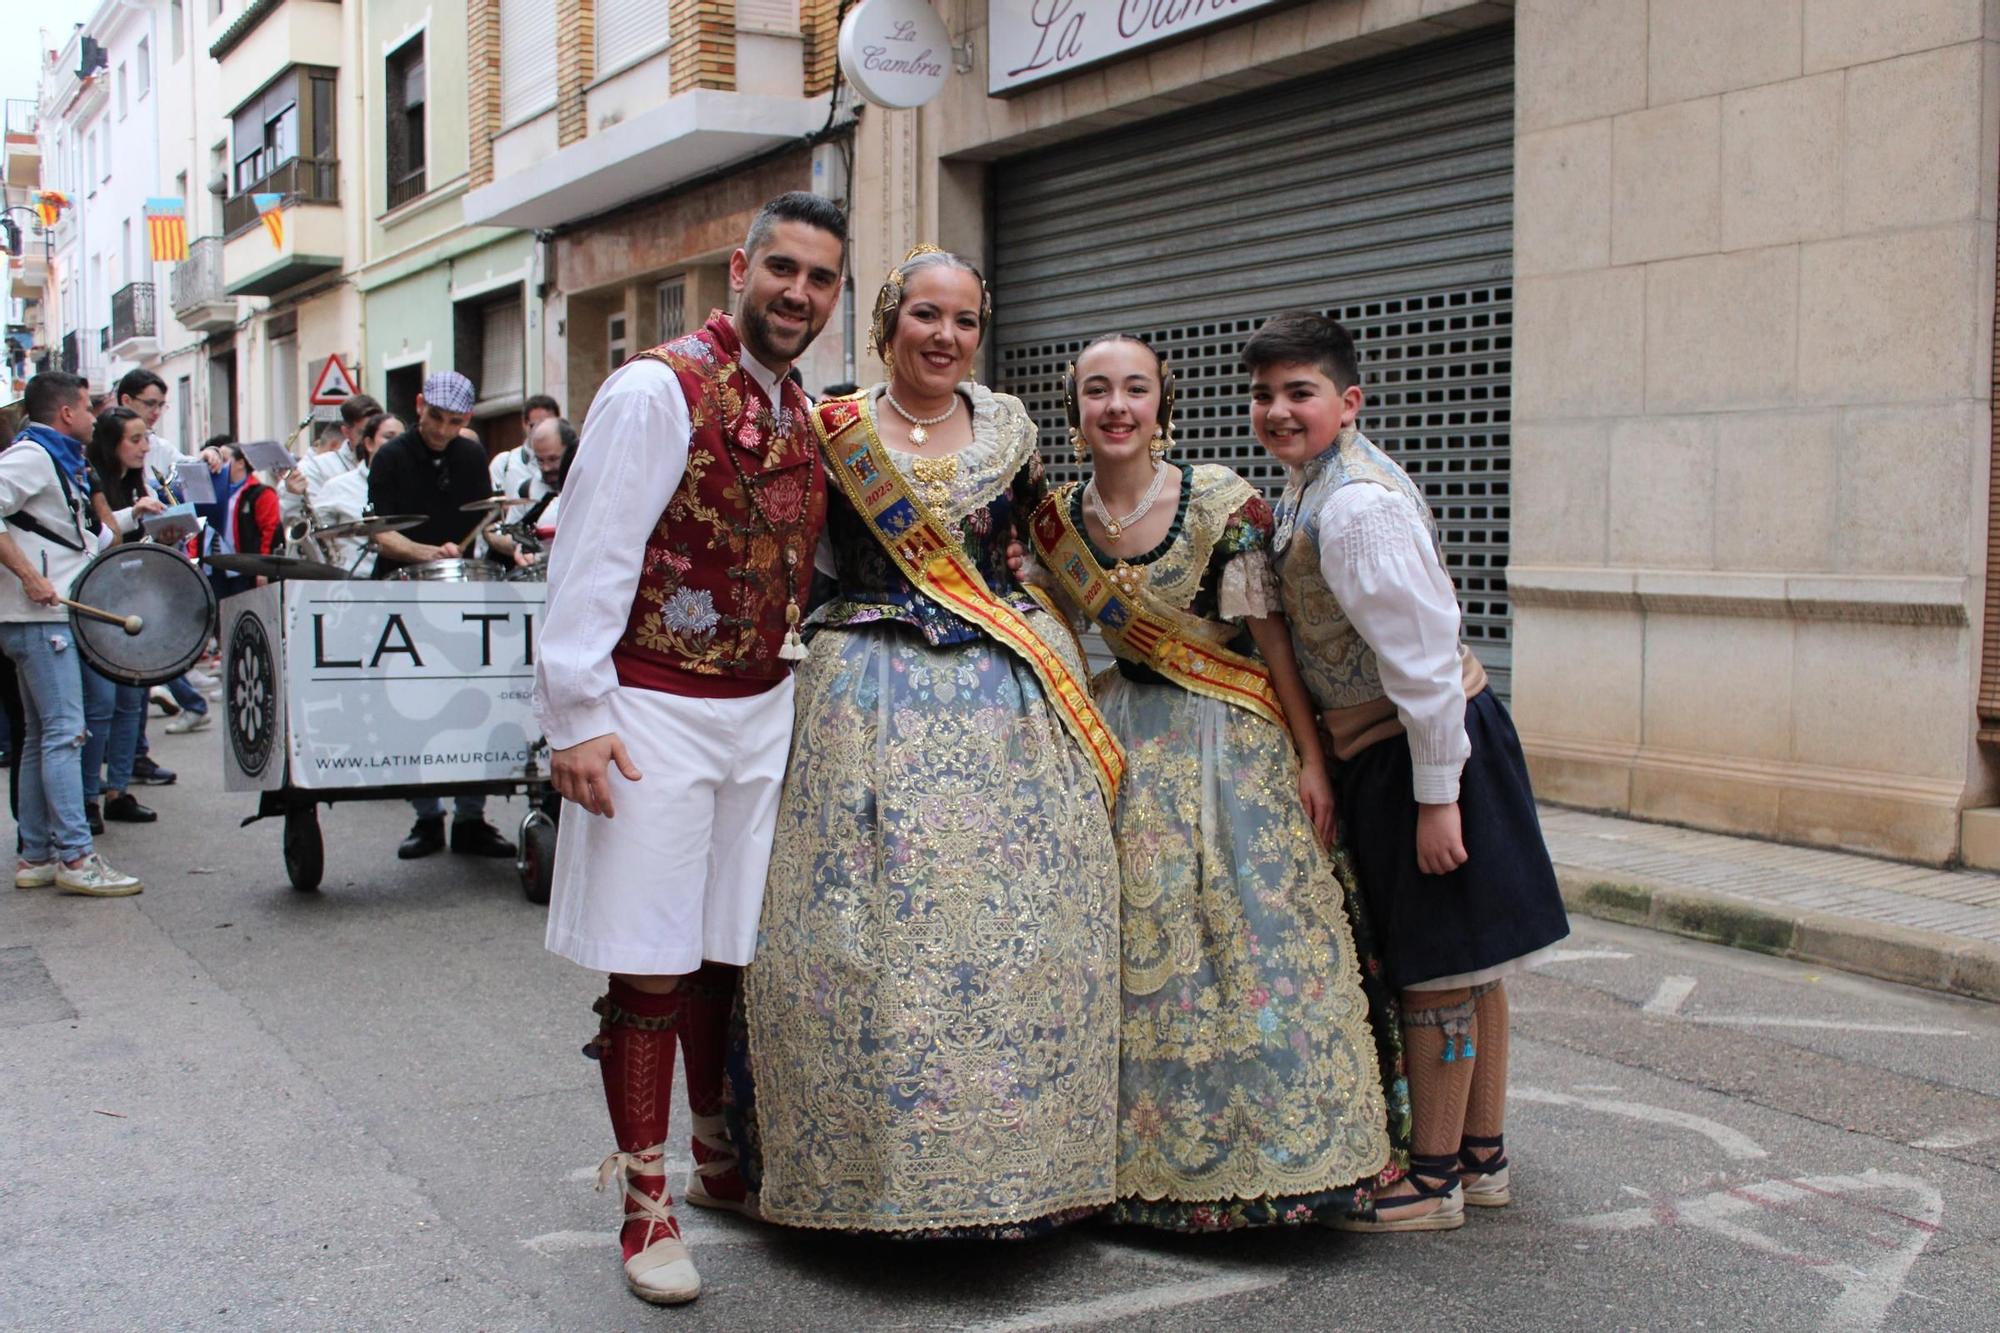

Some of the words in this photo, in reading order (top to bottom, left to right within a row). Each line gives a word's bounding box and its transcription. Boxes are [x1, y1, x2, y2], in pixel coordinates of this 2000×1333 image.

[884, 20, 917, 42] La
[1007, 0, 1086, 76] La
[863, 45, 942, 77] Cambra
[865, 479, 894, 506] 2025
[1084, 579, 1103, 605] 2025
[312, 612, 425, 668] LA
[461, 612, 535, 667] TI
[315, 750, 551, 770] WWW.LATIMBAMURCIA.CM
